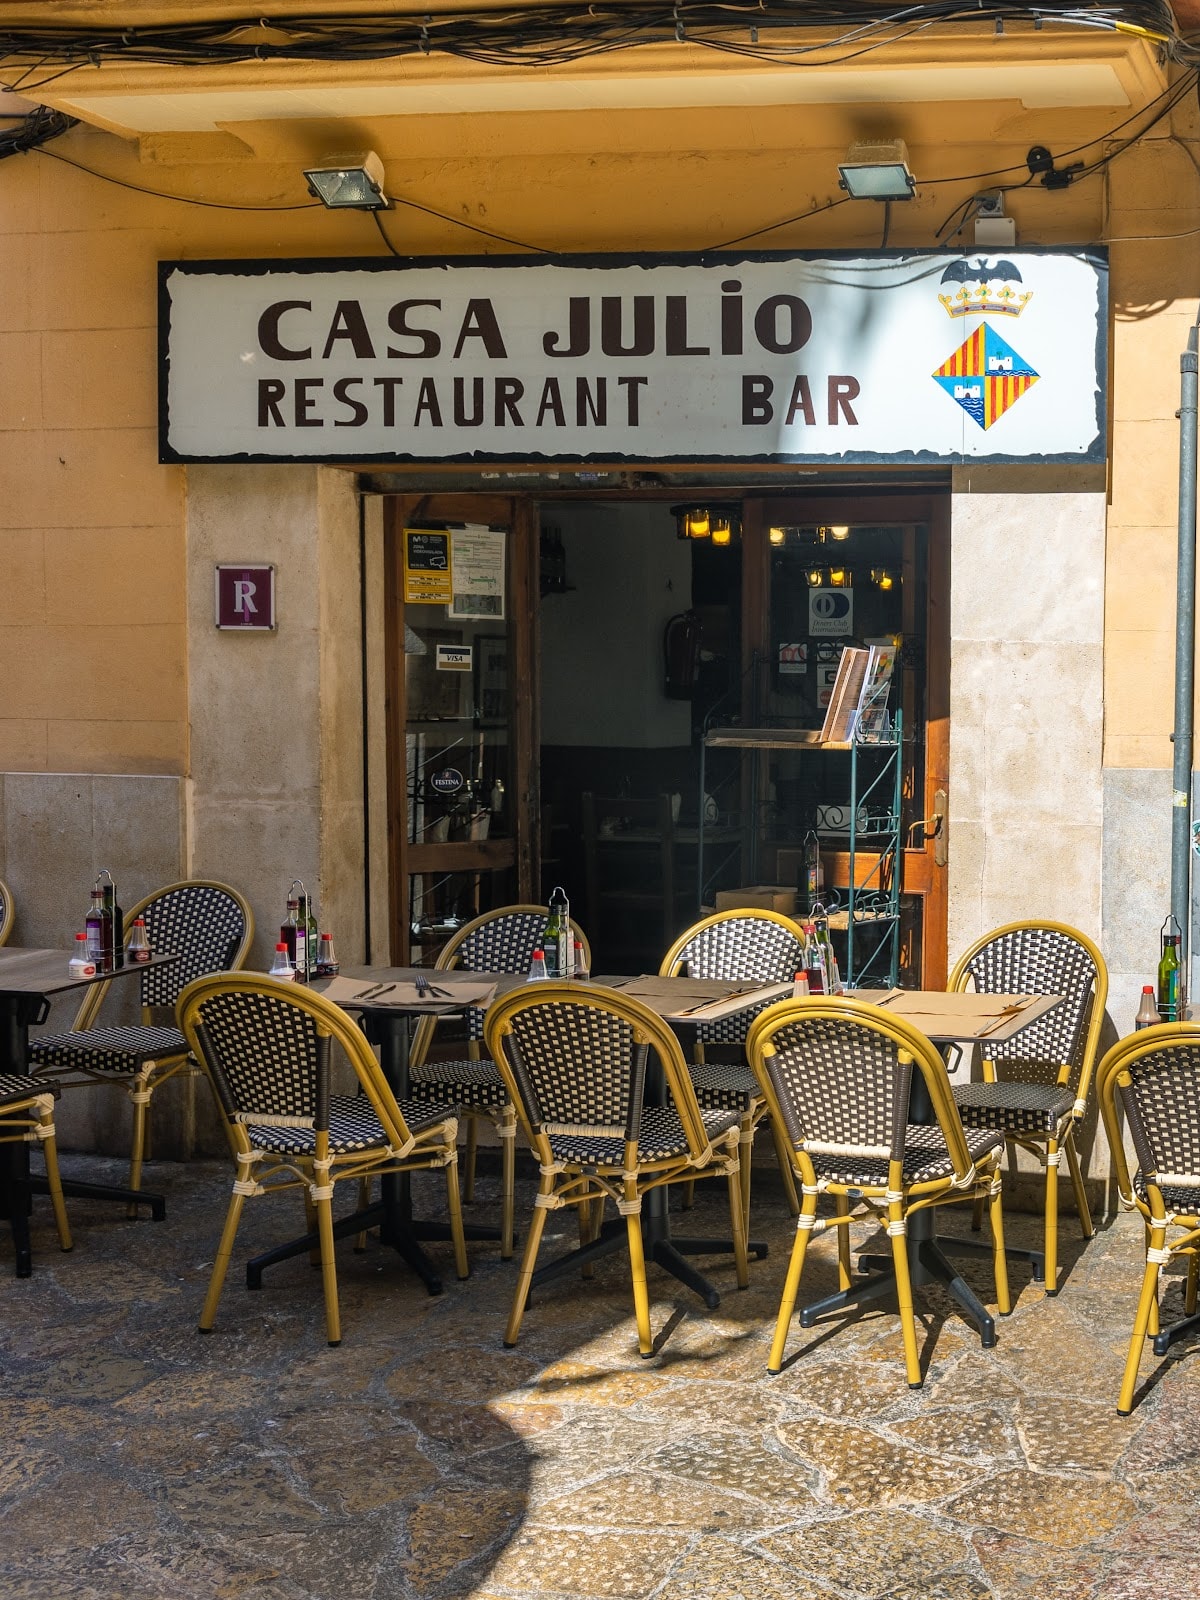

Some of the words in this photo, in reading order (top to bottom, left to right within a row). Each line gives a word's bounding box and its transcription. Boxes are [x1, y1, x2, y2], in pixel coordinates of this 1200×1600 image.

[257, 298, 509, 362] CASA
[257, 376, 650, 429] RESTAURANT
[741, 374, 860, 427] BAR
[233, 580, 259, 613] R
[446, 654, 463, 662] VISA
